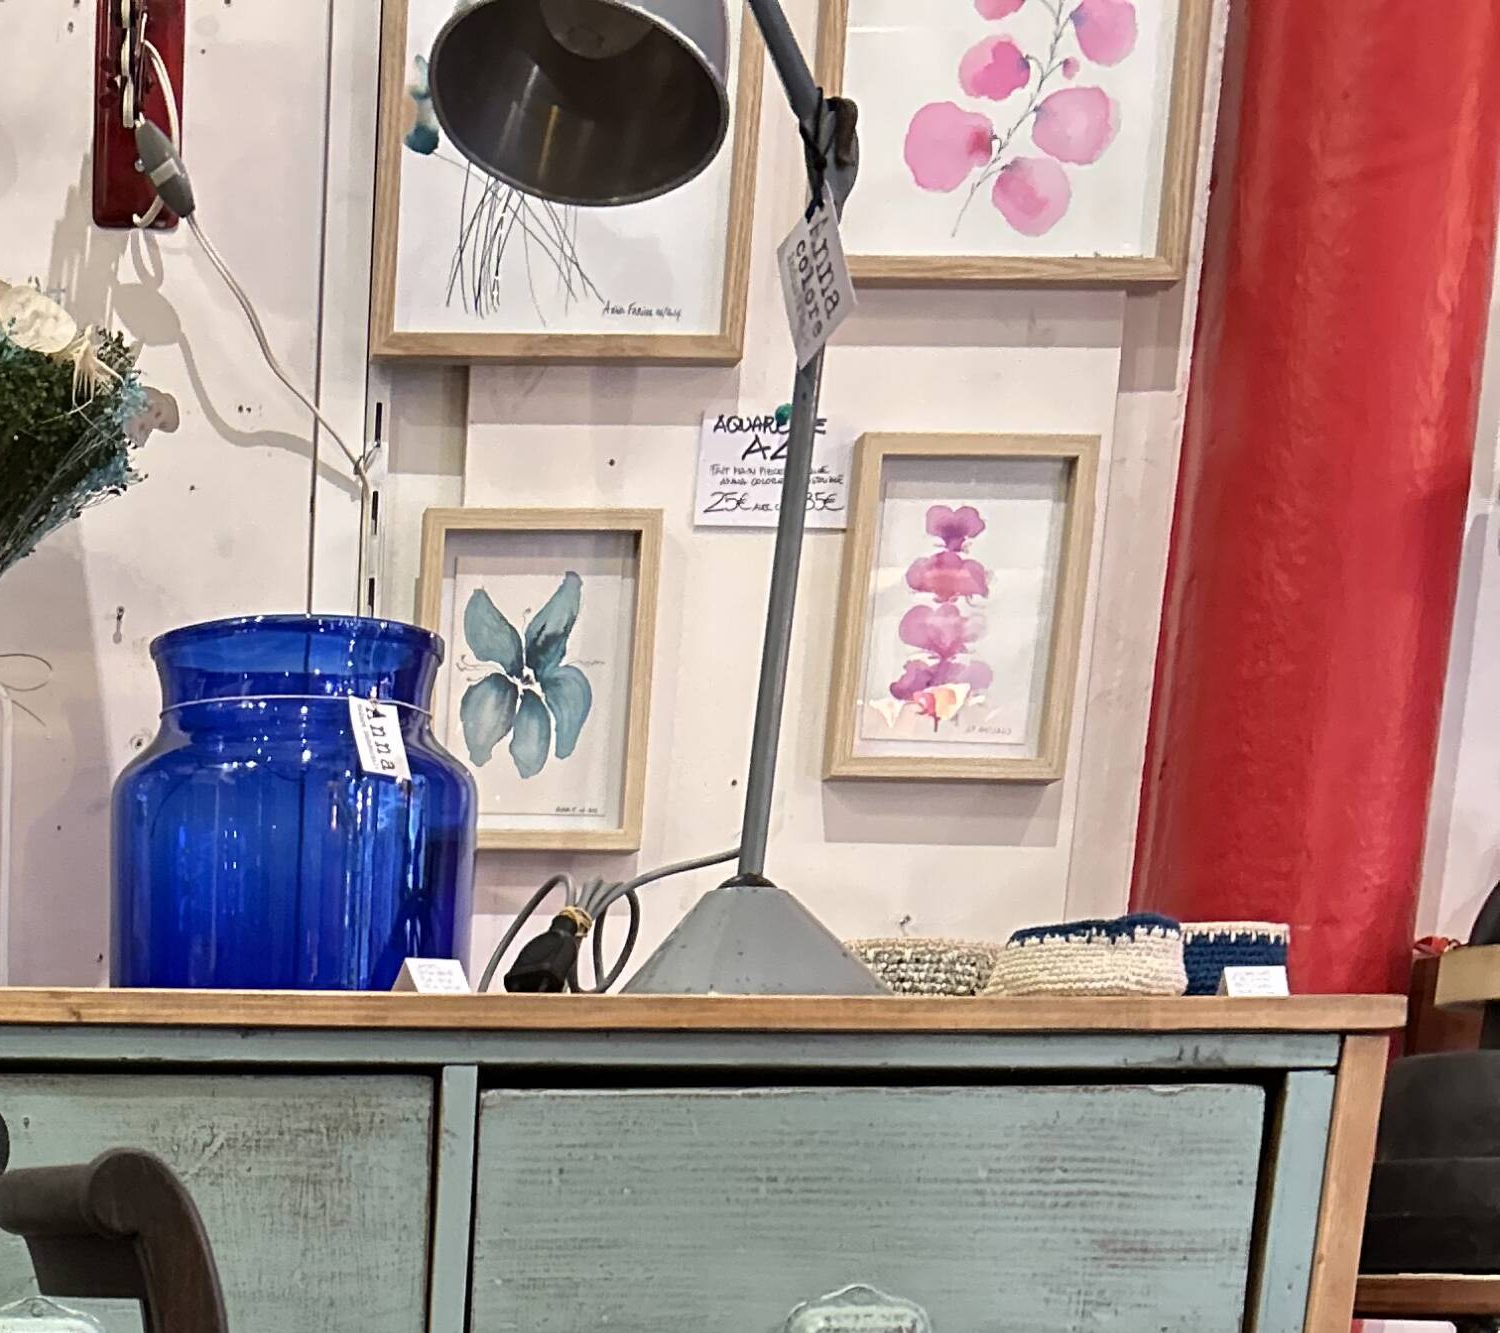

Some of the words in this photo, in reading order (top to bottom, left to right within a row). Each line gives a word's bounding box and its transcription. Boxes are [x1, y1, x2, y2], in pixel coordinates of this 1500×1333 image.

[796, 240, 823, 338] colore
[809, 216, 840, 320] Anna
[713, 414, 828, 435] AQUARE
[703, 491, 750, 513] 25€
[366, 707, 396, 771] Anna
